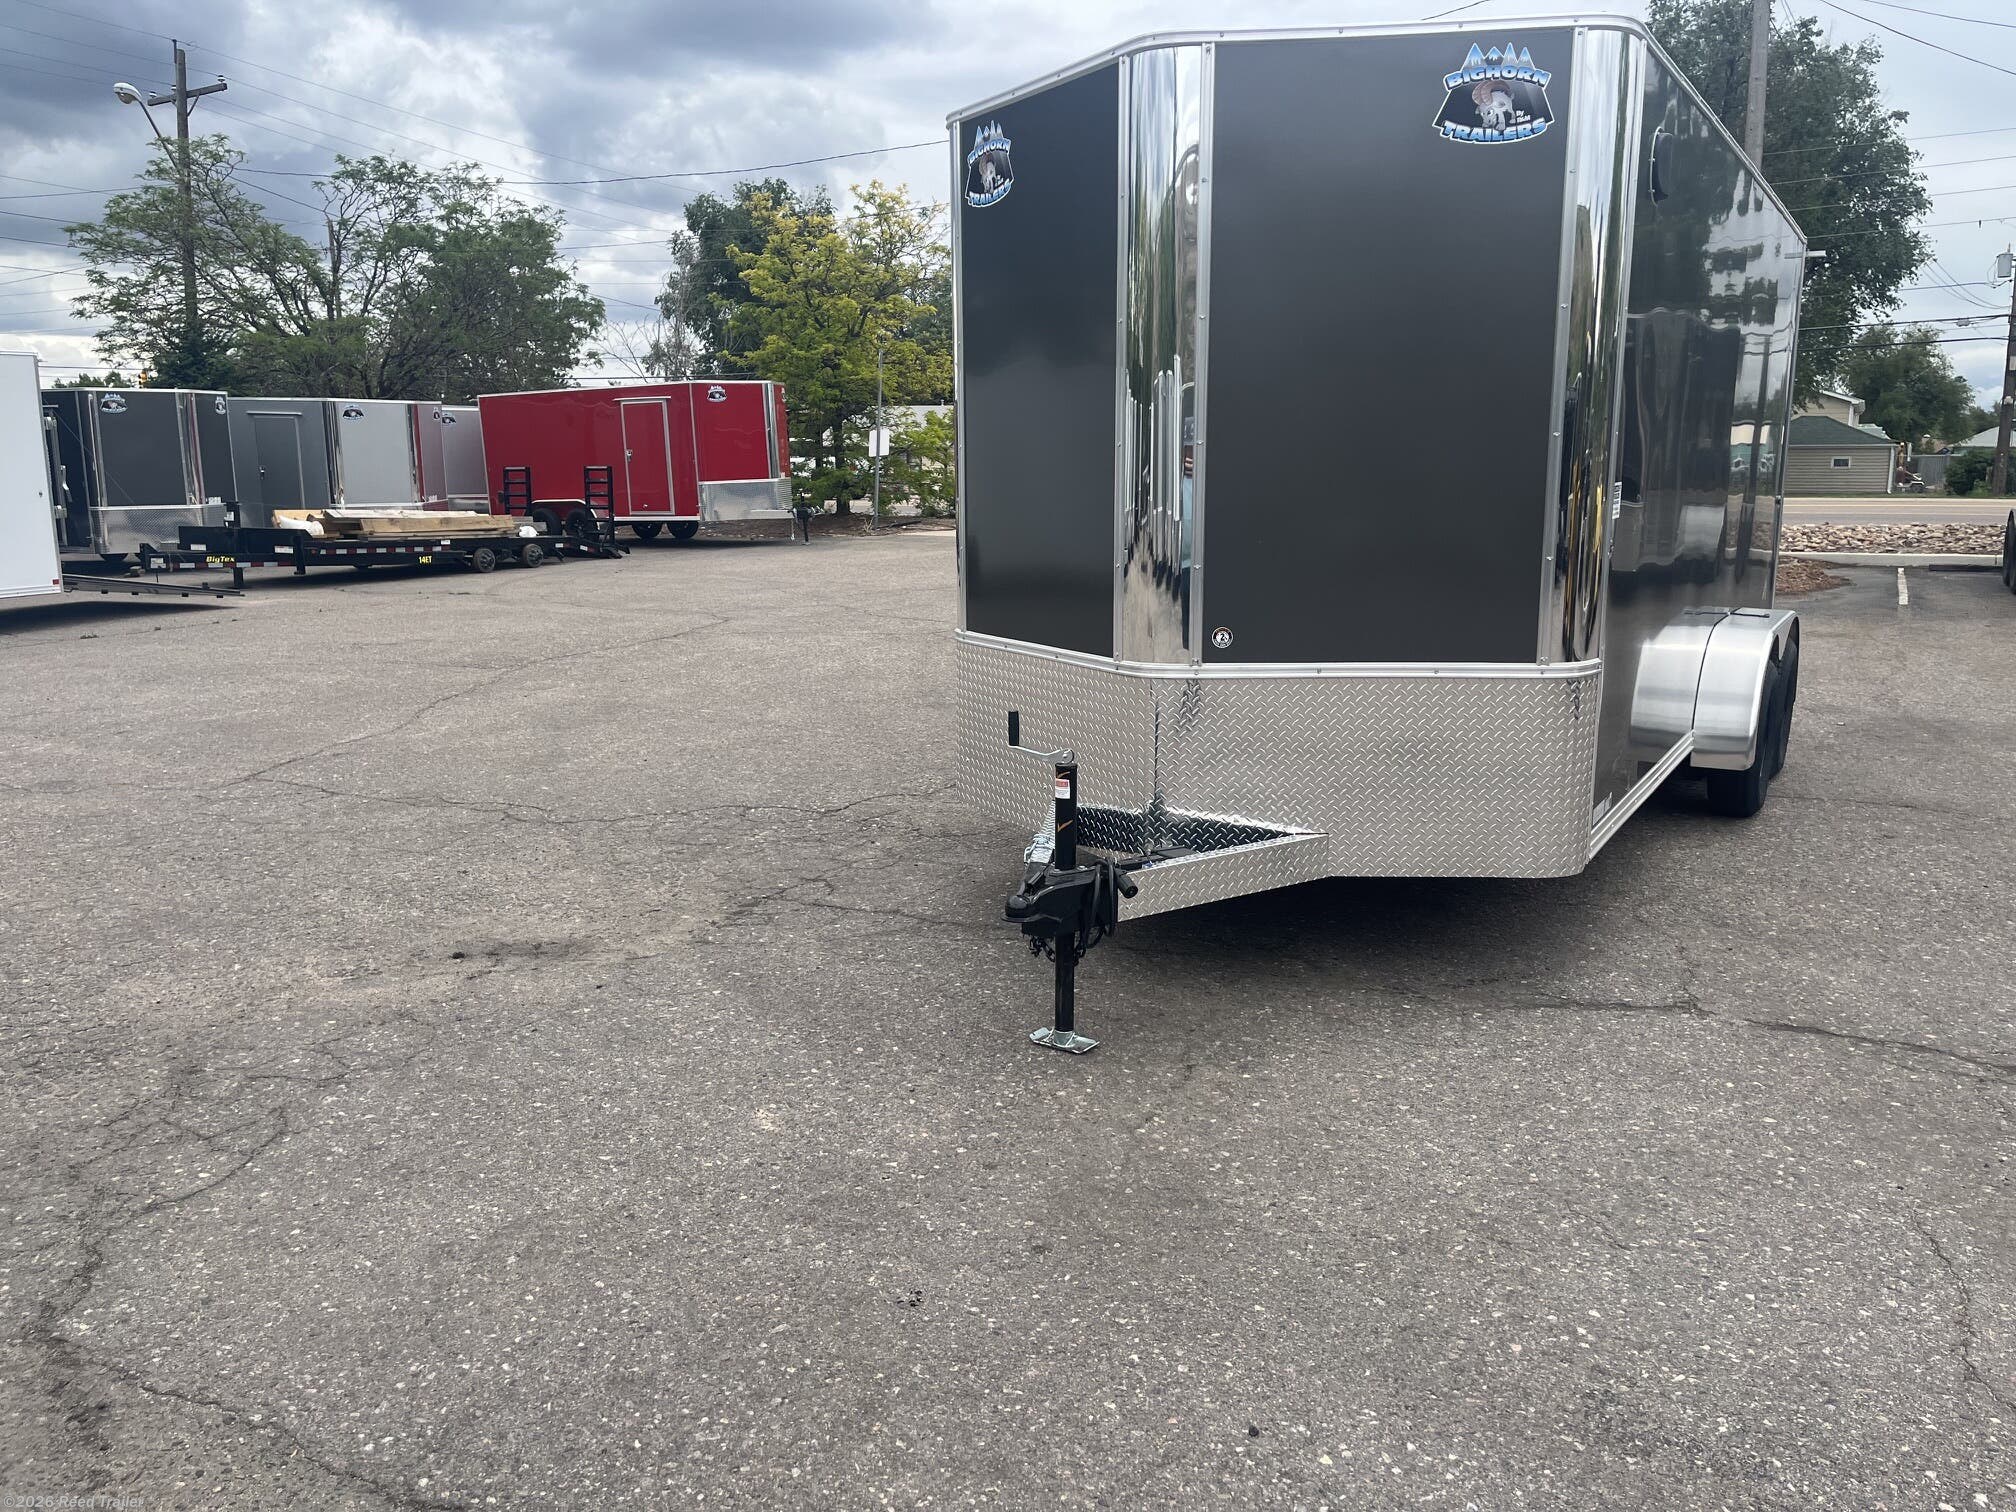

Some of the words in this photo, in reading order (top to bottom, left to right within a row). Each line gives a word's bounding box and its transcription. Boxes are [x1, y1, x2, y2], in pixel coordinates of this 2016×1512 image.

[1445, 65, 1549, 89] BIGHORN
[1442, 117, 1546, 142] TRAILERS
[967, 138, 1010, 165] BIGHORN
[968, 178, 1011, 206] TRAILERS
[205, 555, 235, 564] BigTex
[418, 555, 432, 564] 14ET
